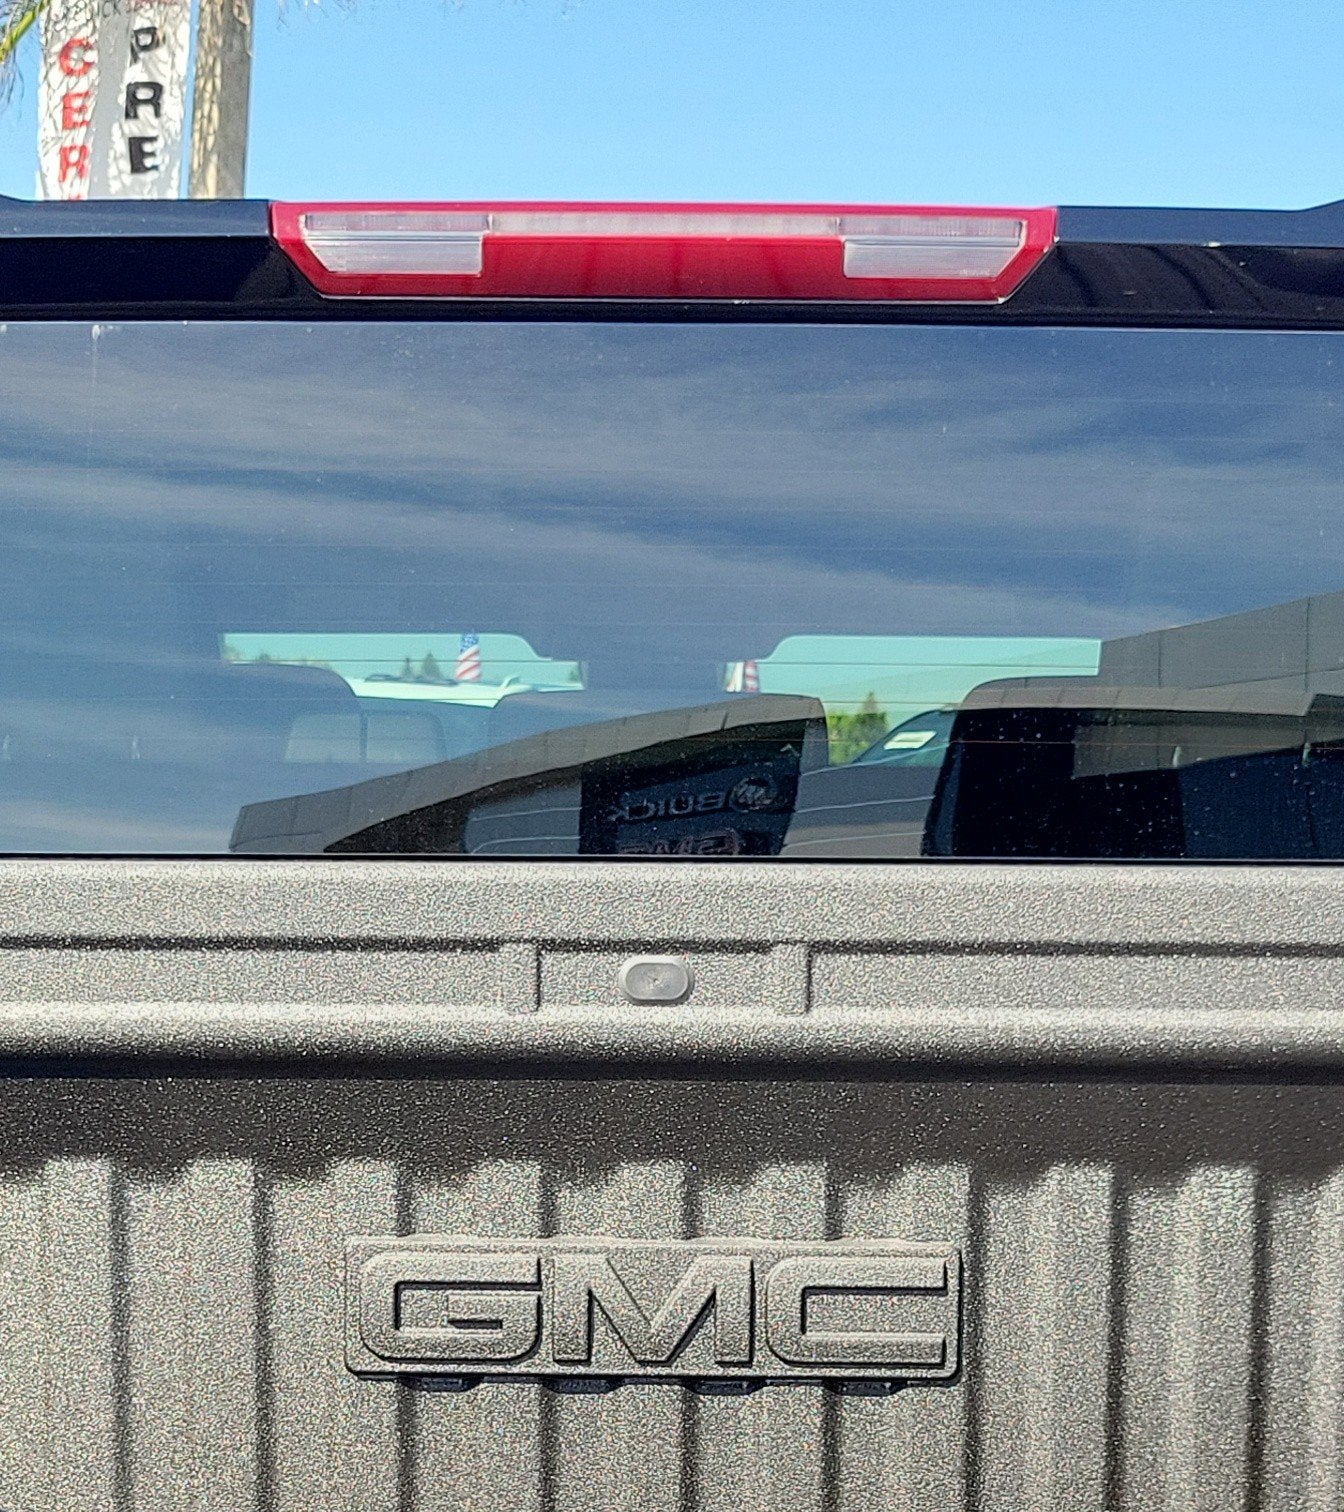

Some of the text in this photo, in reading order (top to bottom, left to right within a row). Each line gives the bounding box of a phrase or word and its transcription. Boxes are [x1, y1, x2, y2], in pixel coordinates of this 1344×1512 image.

[58, 36, 96, 199] CER
[123, 26, 165, 175] PRE
[359, 1251, 950, 1367] GMC
